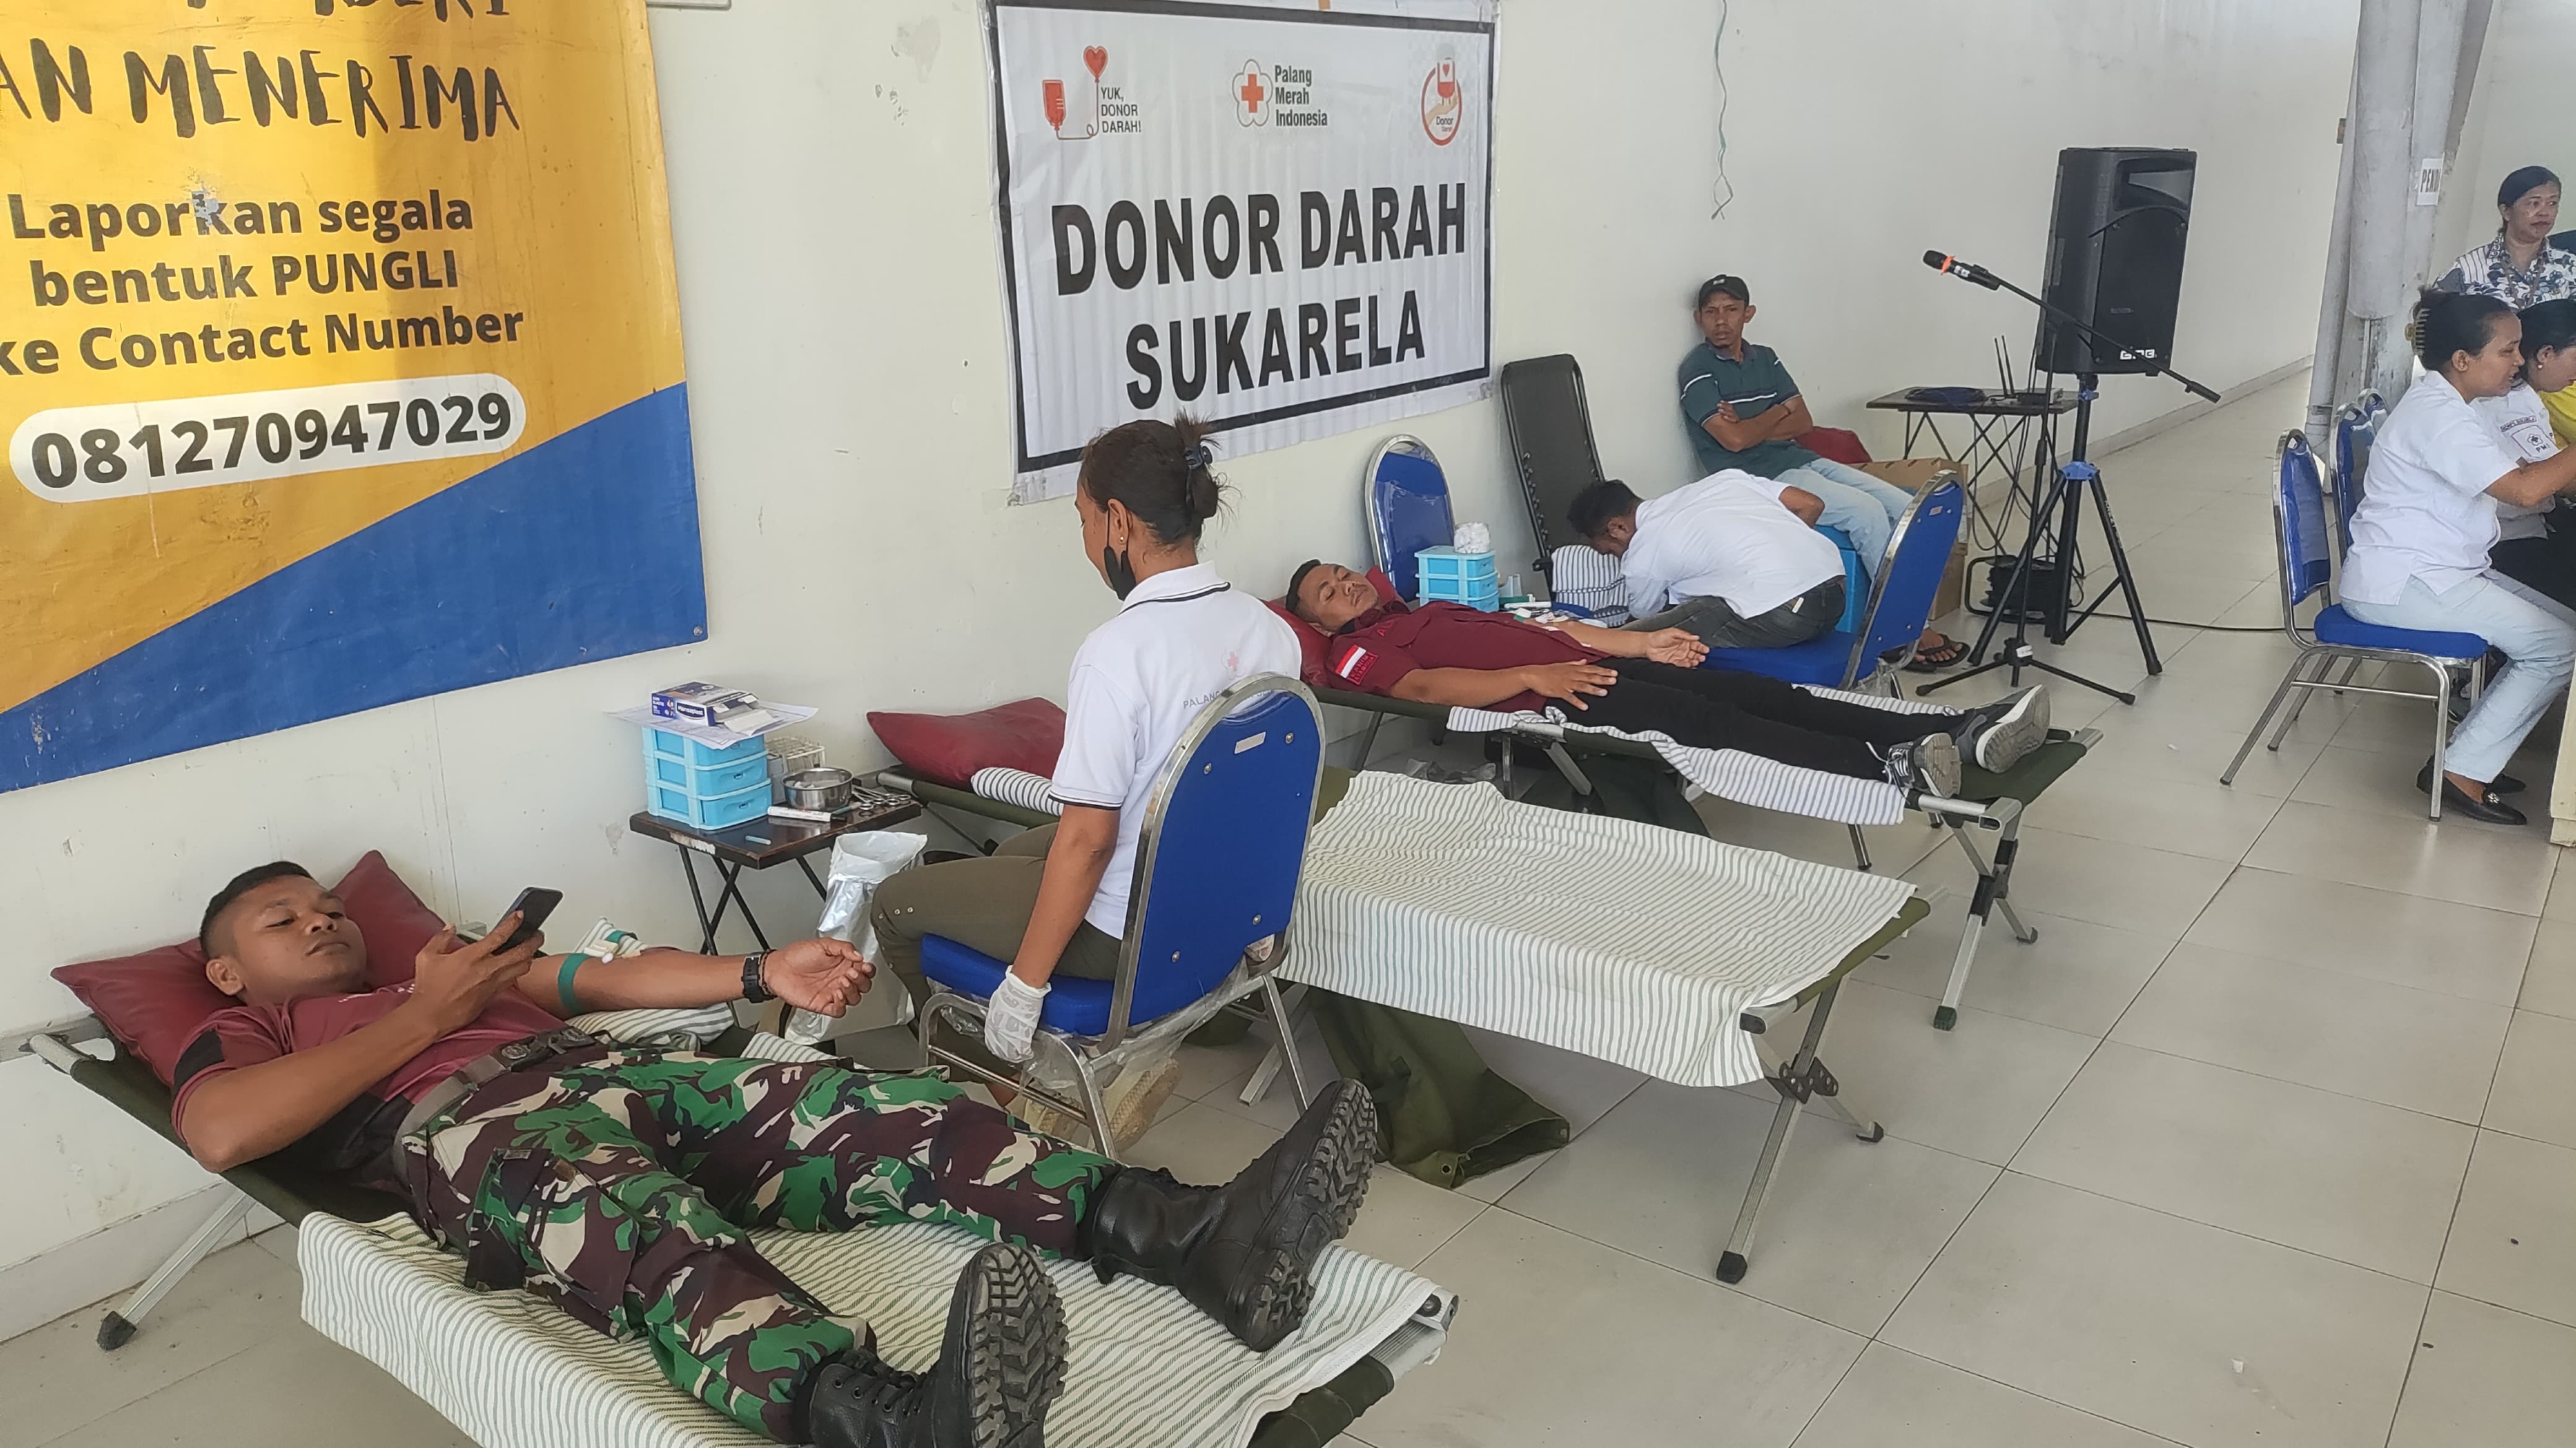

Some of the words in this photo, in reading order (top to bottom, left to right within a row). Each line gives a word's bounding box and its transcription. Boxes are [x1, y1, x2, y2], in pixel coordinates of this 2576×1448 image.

[123, 45, 520, 142] MENERIMA
[1101, 87, 1124, 102] YUK,
[1274, 64, 1312, 87] Palang
[1101, 103, 1138, 116] DONOR
[1275, 87, 1310, 105] Merah
[1102, 120, 1141, 133] DARAH!
[1276, 109, 1328, 126] Indonesia
[1436, 116, 1453, 125] Donor
[7, 193, 302, 252] Laporkan
[318, 189, 473, 243] segala
[1051, 194, 1284, 296] DONOR
[1300, 183, 1466, 270] DARAH
[30, 254, 258, 306] bentuk
[272, 249, 458, 295] PUNGLI
[79, 319, 311, 370] Contact
[324, 305, 523, 353] Number
[1126, 290, 1425, 410] SUKARELA
[31, 392, 511, 489] 081270947029
